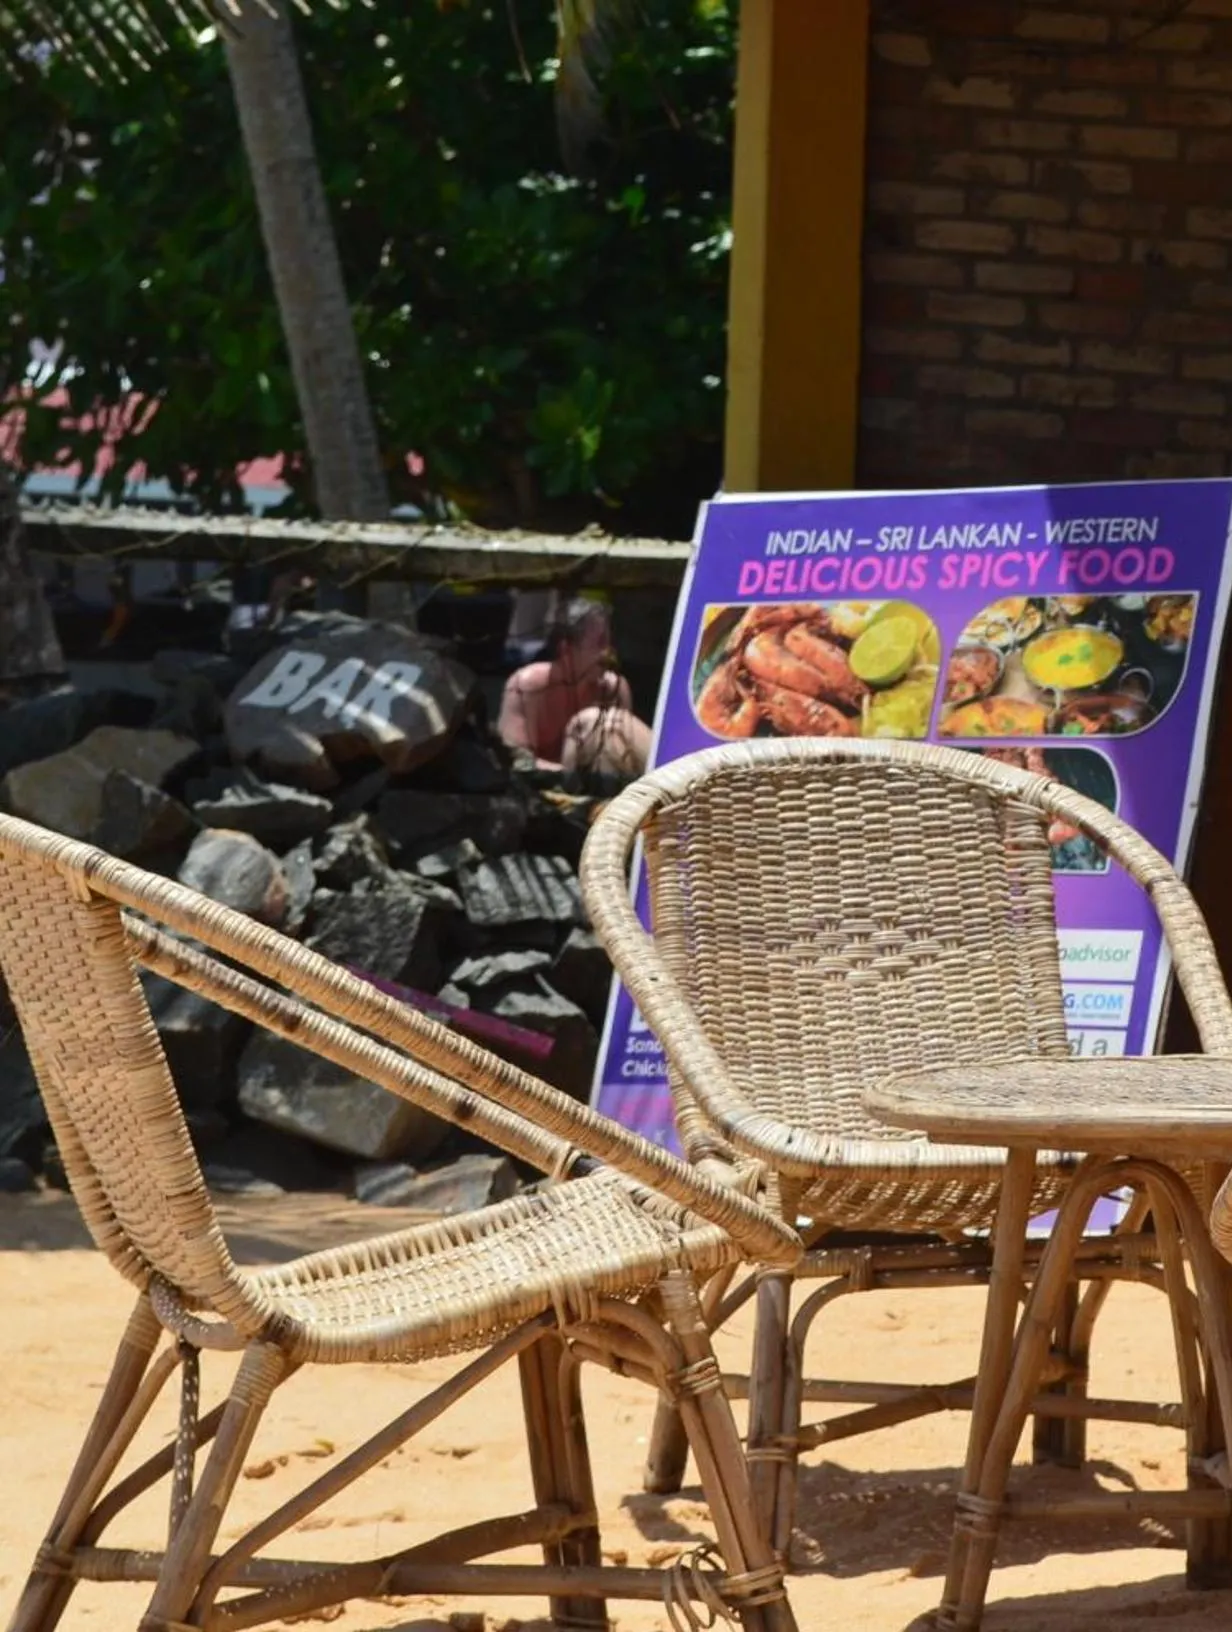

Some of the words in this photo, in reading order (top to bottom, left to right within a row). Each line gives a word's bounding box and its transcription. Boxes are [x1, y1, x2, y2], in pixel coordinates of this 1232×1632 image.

[765, 529, 853, 556] INDIAN
[875, 526, 914, 552] SRI
[917, 522, 1023, 550] LANKAN
[1045, 517, 1159, 545] WESTERN
[737, 554, 929, 596] DELICIOUS
[937, 551, 1049, 589] SPICY
[1058, 546, 1175, 585] FOOD
[238, 651, 422, 737] BAR
